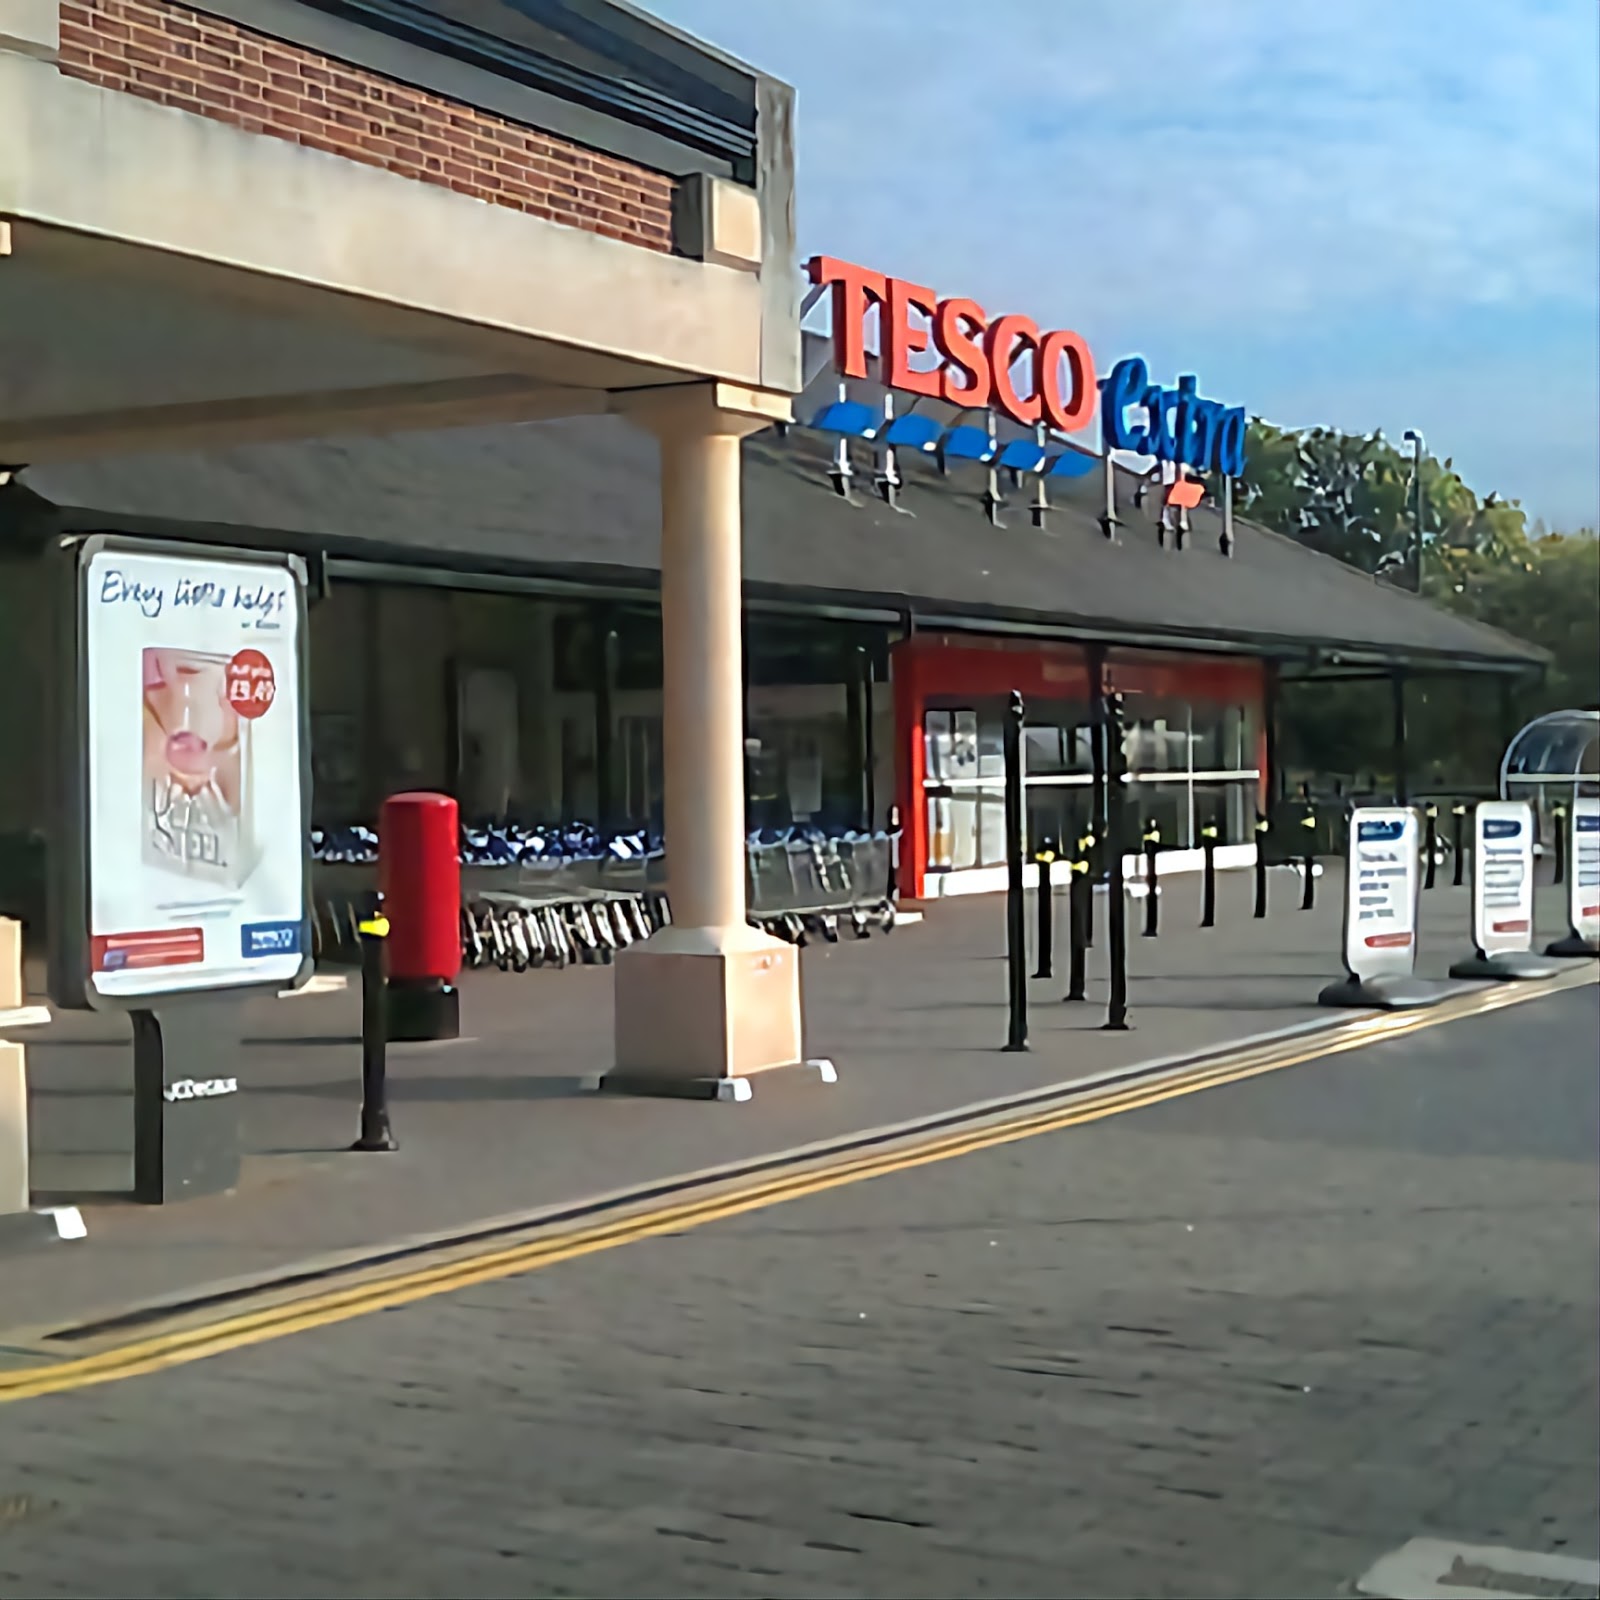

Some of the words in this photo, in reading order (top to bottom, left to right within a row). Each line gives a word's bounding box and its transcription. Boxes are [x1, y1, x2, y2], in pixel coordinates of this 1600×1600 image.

[807, 255, 1097, 432] TESCO
[1098, 357, 1248, 477] Extra
[100, 570, 163, 618] Every
